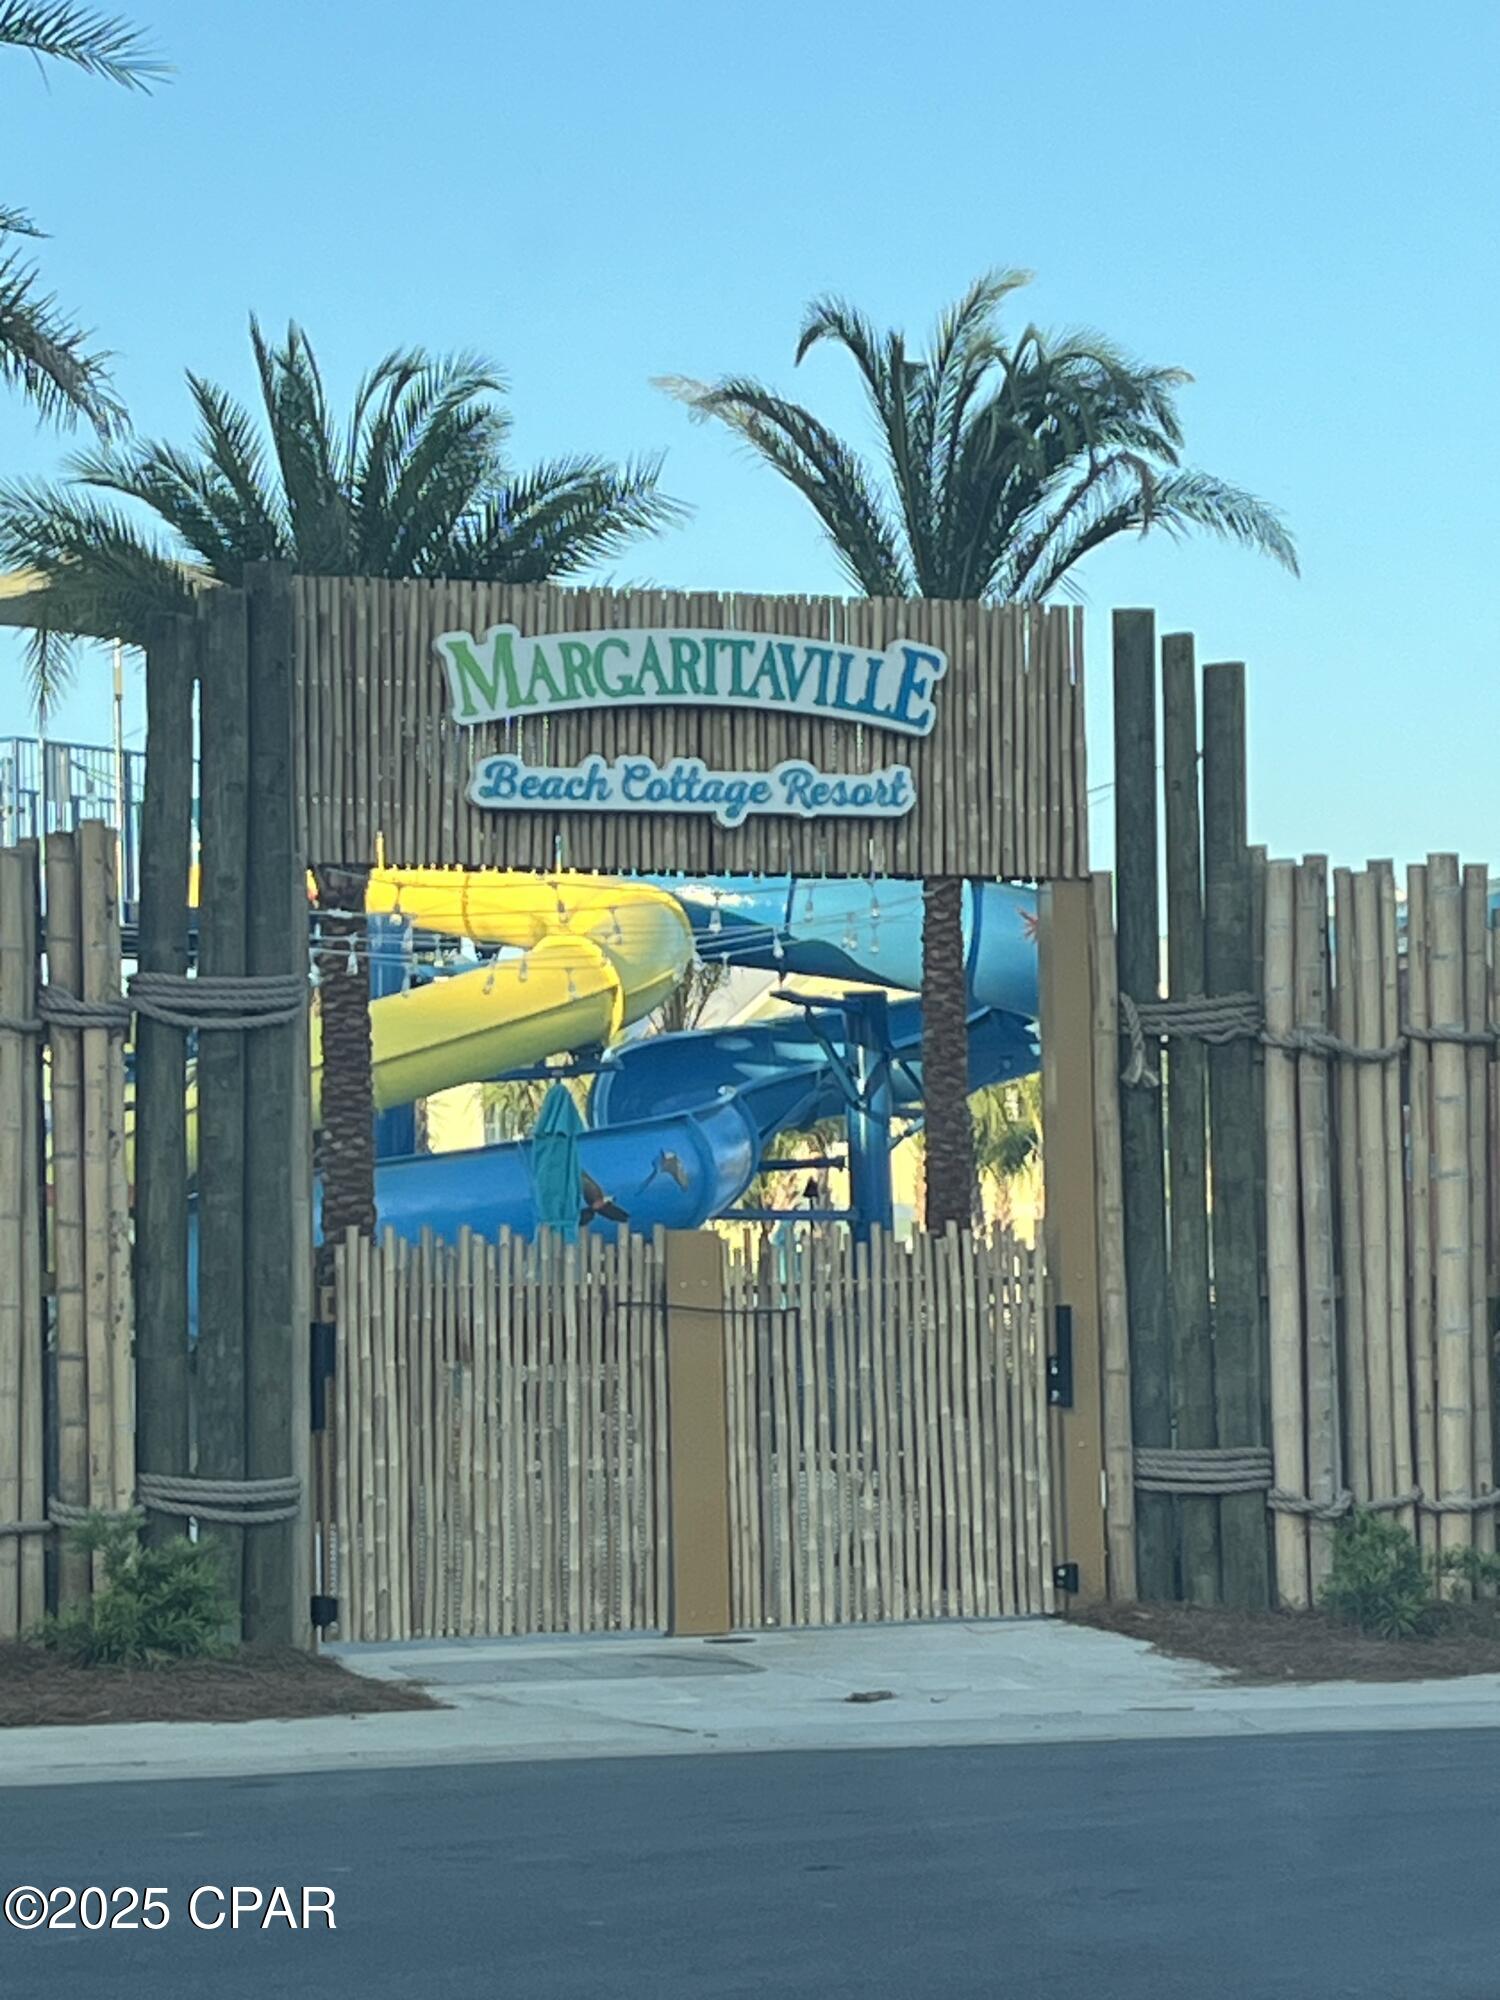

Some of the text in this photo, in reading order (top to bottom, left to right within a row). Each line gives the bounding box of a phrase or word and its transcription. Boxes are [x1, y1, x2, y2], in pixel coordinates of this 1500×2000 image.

[445, 632, 941, 730] MARGARITAVILLE
[478, 759, 908, 820] Beach Cottage Resort
